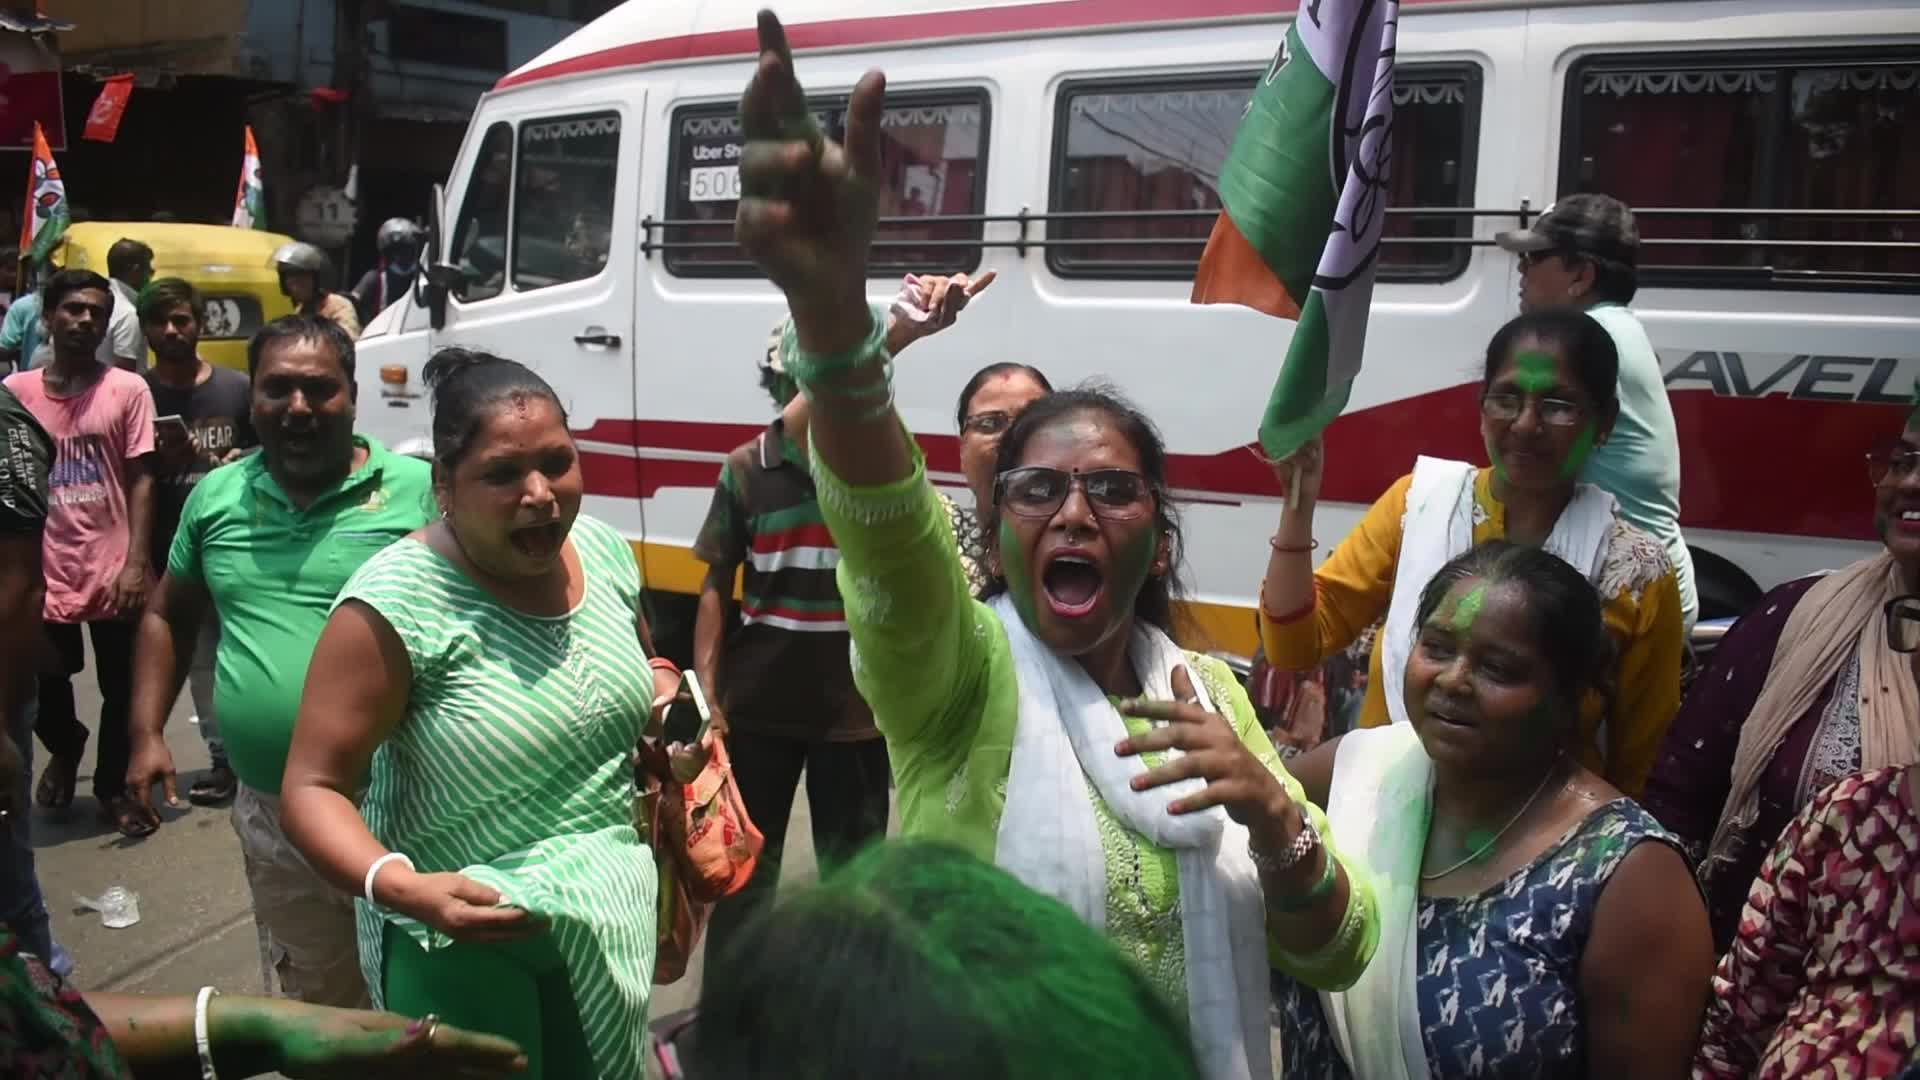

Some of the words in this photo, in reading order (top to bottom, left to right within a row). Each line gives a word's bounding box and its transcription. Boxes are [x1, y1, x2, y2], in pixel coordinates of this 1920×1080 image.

[692, 144, 723, 161] Uber
[723, 143, 743, 160] Sh
[1656, 350, 1914, 403] AVEL
